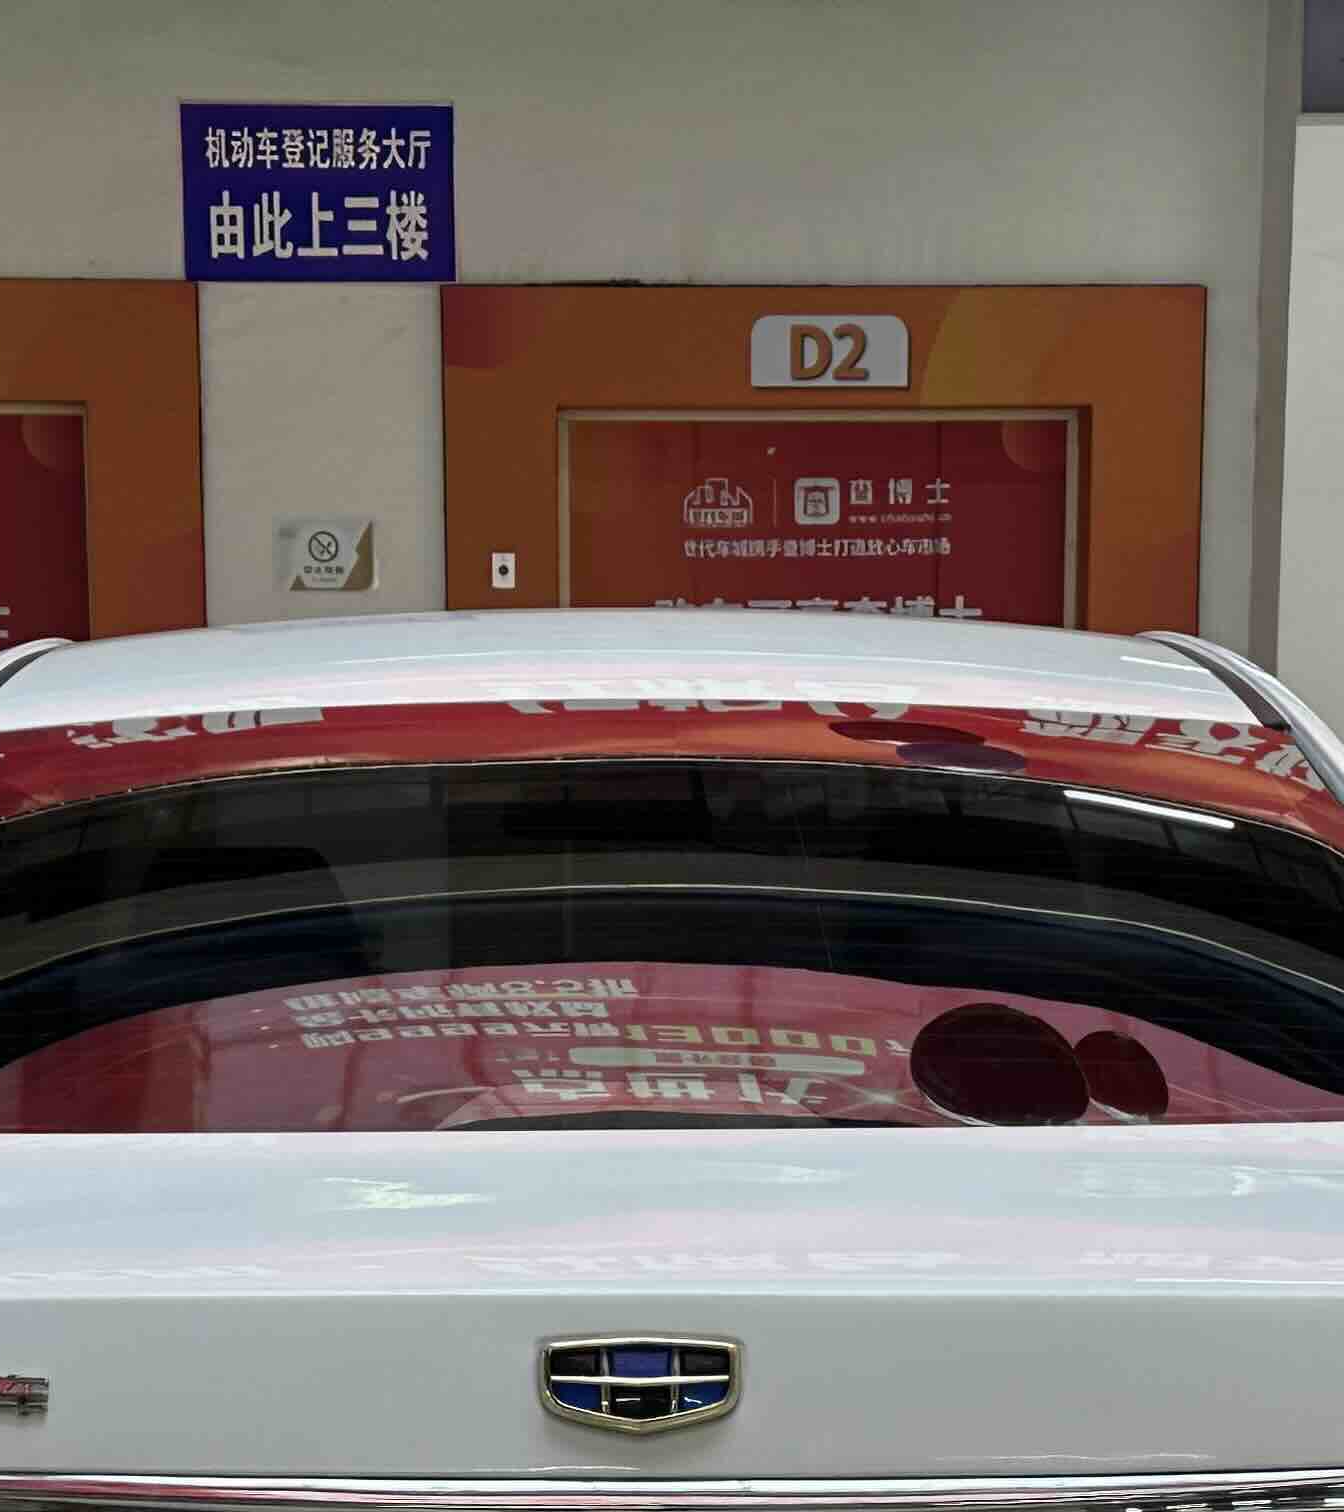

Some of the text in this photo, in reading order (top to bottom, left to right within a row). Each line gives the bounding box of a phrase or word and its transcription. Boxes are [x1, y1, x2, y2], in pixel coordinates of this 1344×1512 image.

[205, 127, 432, 169] 机动车登记服务大厅
[209, 190, 429, 260] 由此上三楼
[790, 323, 870, 381] D2
